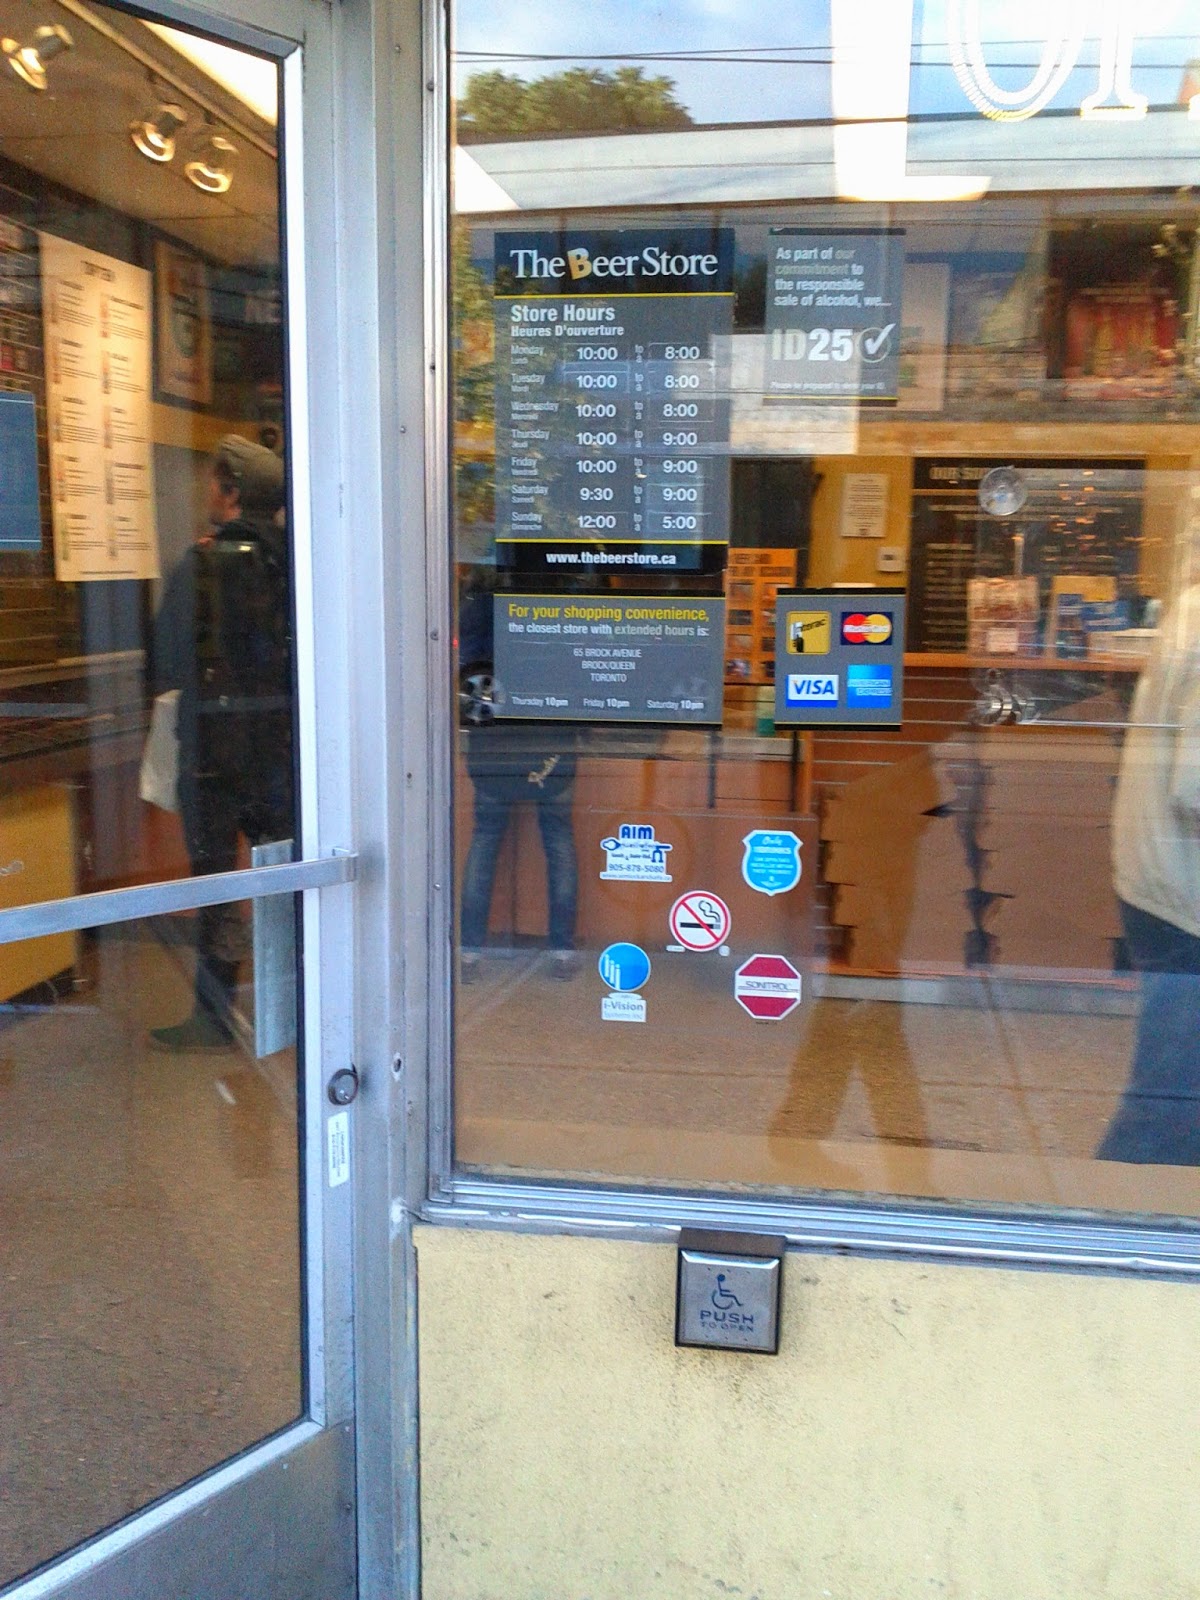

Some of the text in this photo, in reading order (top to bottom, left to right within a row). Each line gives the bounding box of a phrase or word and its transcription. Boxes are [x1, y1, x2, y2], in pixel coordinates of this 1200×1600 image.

[776, 247, 792, 260] As
[794, 248, 819, 262] part
[821, 246, 834, 260] of
[510, 246, 718, 280] The Beer Store
[851, 263, 864, 276] to
[775, 278, 865, 293] the responsible
[774, 294, 799, 306] sale
[800, 294, 814, 306] of
[511, 304, 615, 322] Store Hours
[511, 325, 625, 337] Heures D'ouverture
[511, 345, 545, 356] Monday
[576, 347, 619, 360] 10:00
[664, 346, 700, 360] 8:00
[772, 328, 853, 362] ID25
[511, 373, 546, 385] Tuesday
[576, 374, 618, 388] 10:00
[664, 374, 699, 388] 8:00
[511, 401, 559, 412] Wednesday
[575, 404, 617, 417] 10:00
[662, 403, 698, 417] 8:00
[511, 428, 550, 440] Thursday
[576, 432, 617, 445] 10:00
[662, 432, 698, 446] 9:00
[511, 456, 537, 468] Friday
[576, 460, 617, 473] 10:00
[662, 460, 698, 473] 9:00
[511, 485, 549, 496] Saturday
[580, 487, 614, 501] 9:30
[662, 488, 697, 501] 9:00
[511, 511, 543, 523] Sunday
[577, 515, 617, 528] 12:00
[662, 516, 697, 529] 5:00
[545, 551, 677, 565] www.thebeerstore.ca
[508, 603, 709, 622] For your shopping convenience,
[508, 622, 524, 633] the
[526, 622, 561, 634] closest
[563, 623, 589, 634] store
[590, 623, 612, 635] with
[614, 624, 663, 636] extended
[665, 624, 695, 636] hours
[590, 672, 628, 682] TORONTO
[793, 680, 835, 695] VISA
[545, 697, 569, 708] 10pm
[583, 698, 605, 708] Friday
[606, 698, 630, 709] 10pm
[680, 700, 704, 710] 10pm
[621, 826, 652, 840] AIM
[604, 1000, 644, 1011] i-Vision
[700, 1310, 754, 1324] PUSH
[721, 1323, 754, 1332] OPEN
